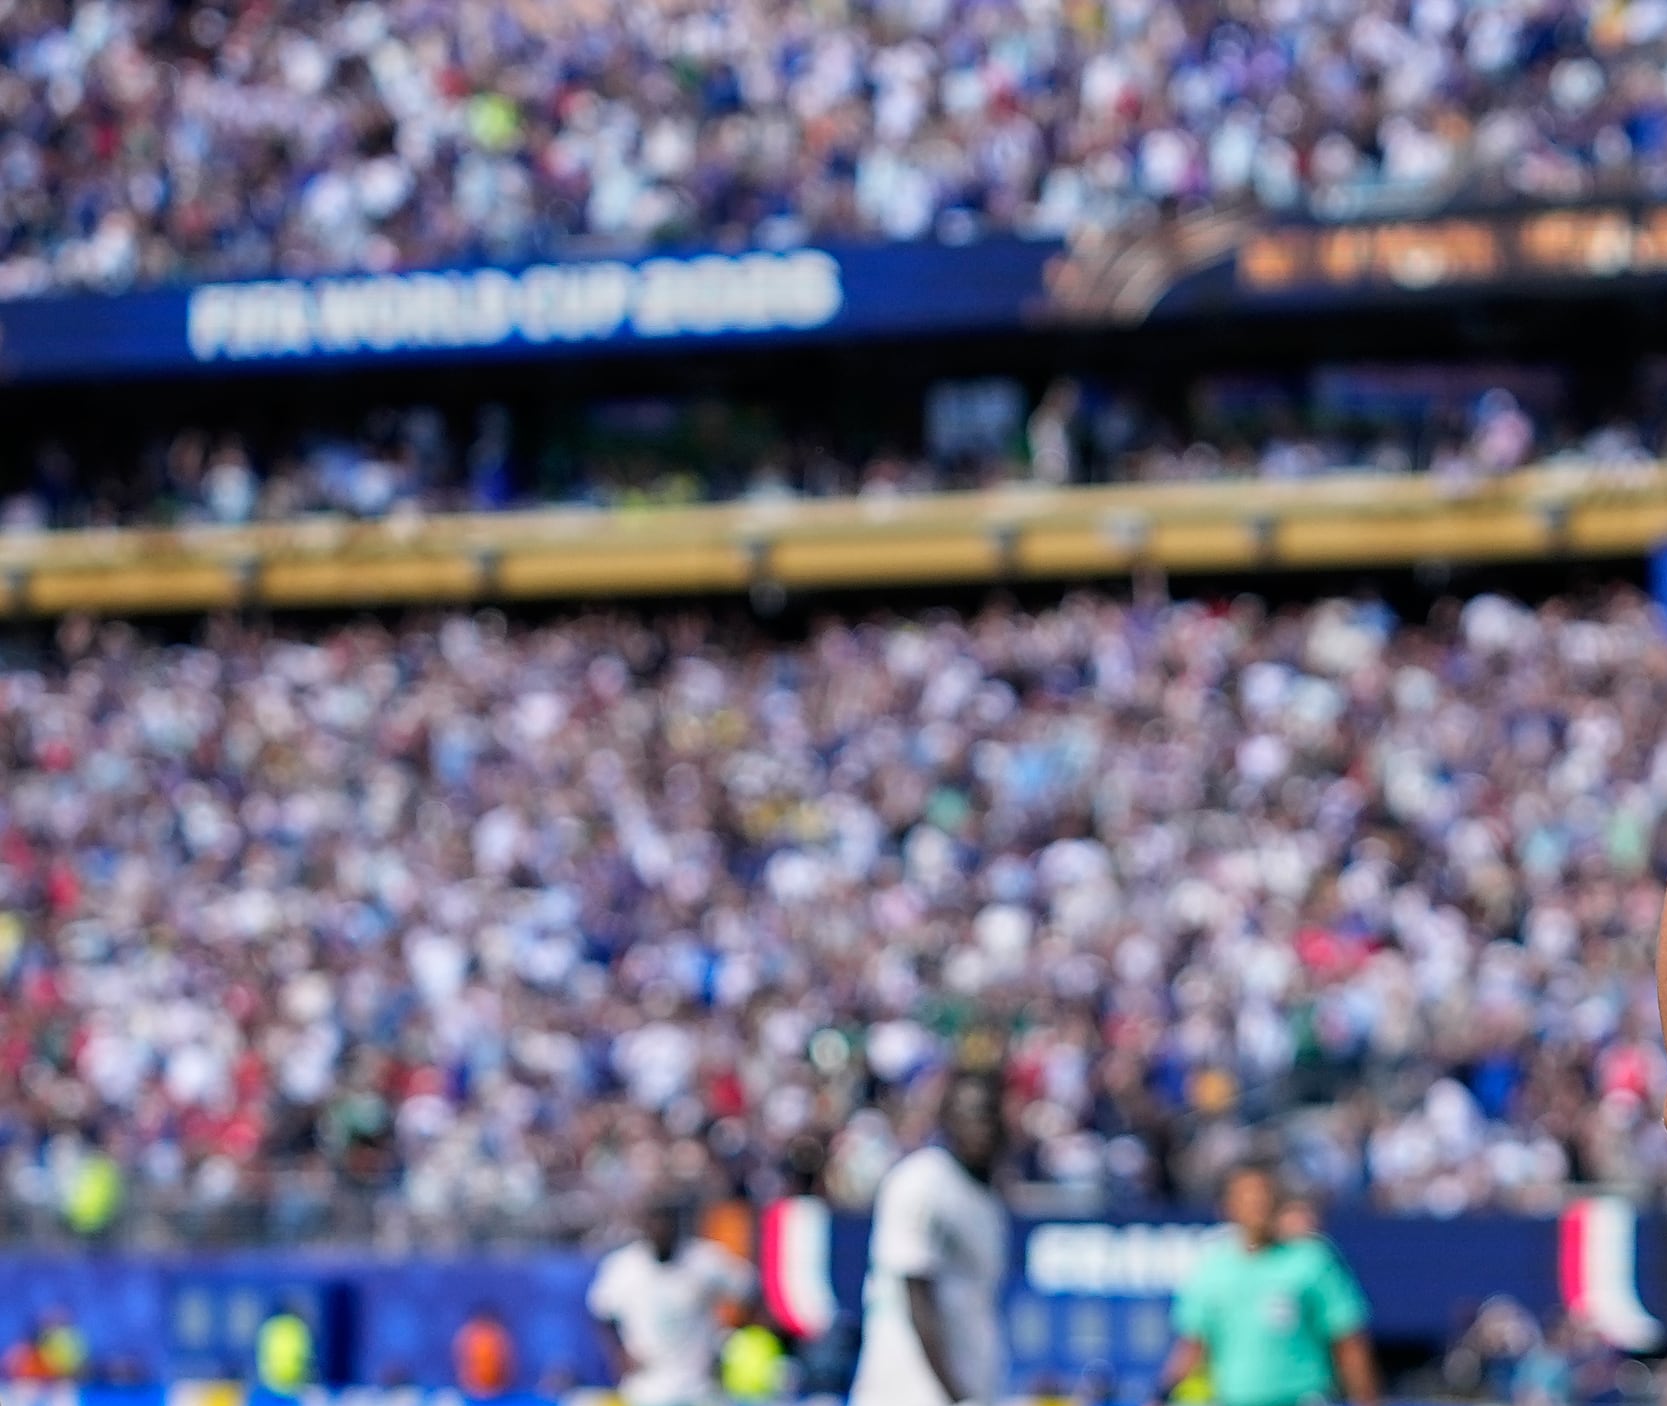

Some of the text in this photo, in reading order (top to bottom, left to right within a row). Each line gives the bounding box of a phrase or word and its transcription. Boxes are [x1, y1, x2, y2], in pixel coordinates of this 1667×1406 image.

[316, 272, 512, 354] WORLD
[517, 260, 630, 343] CUP
[1025, 1222, 1210, 1294] FRAN
